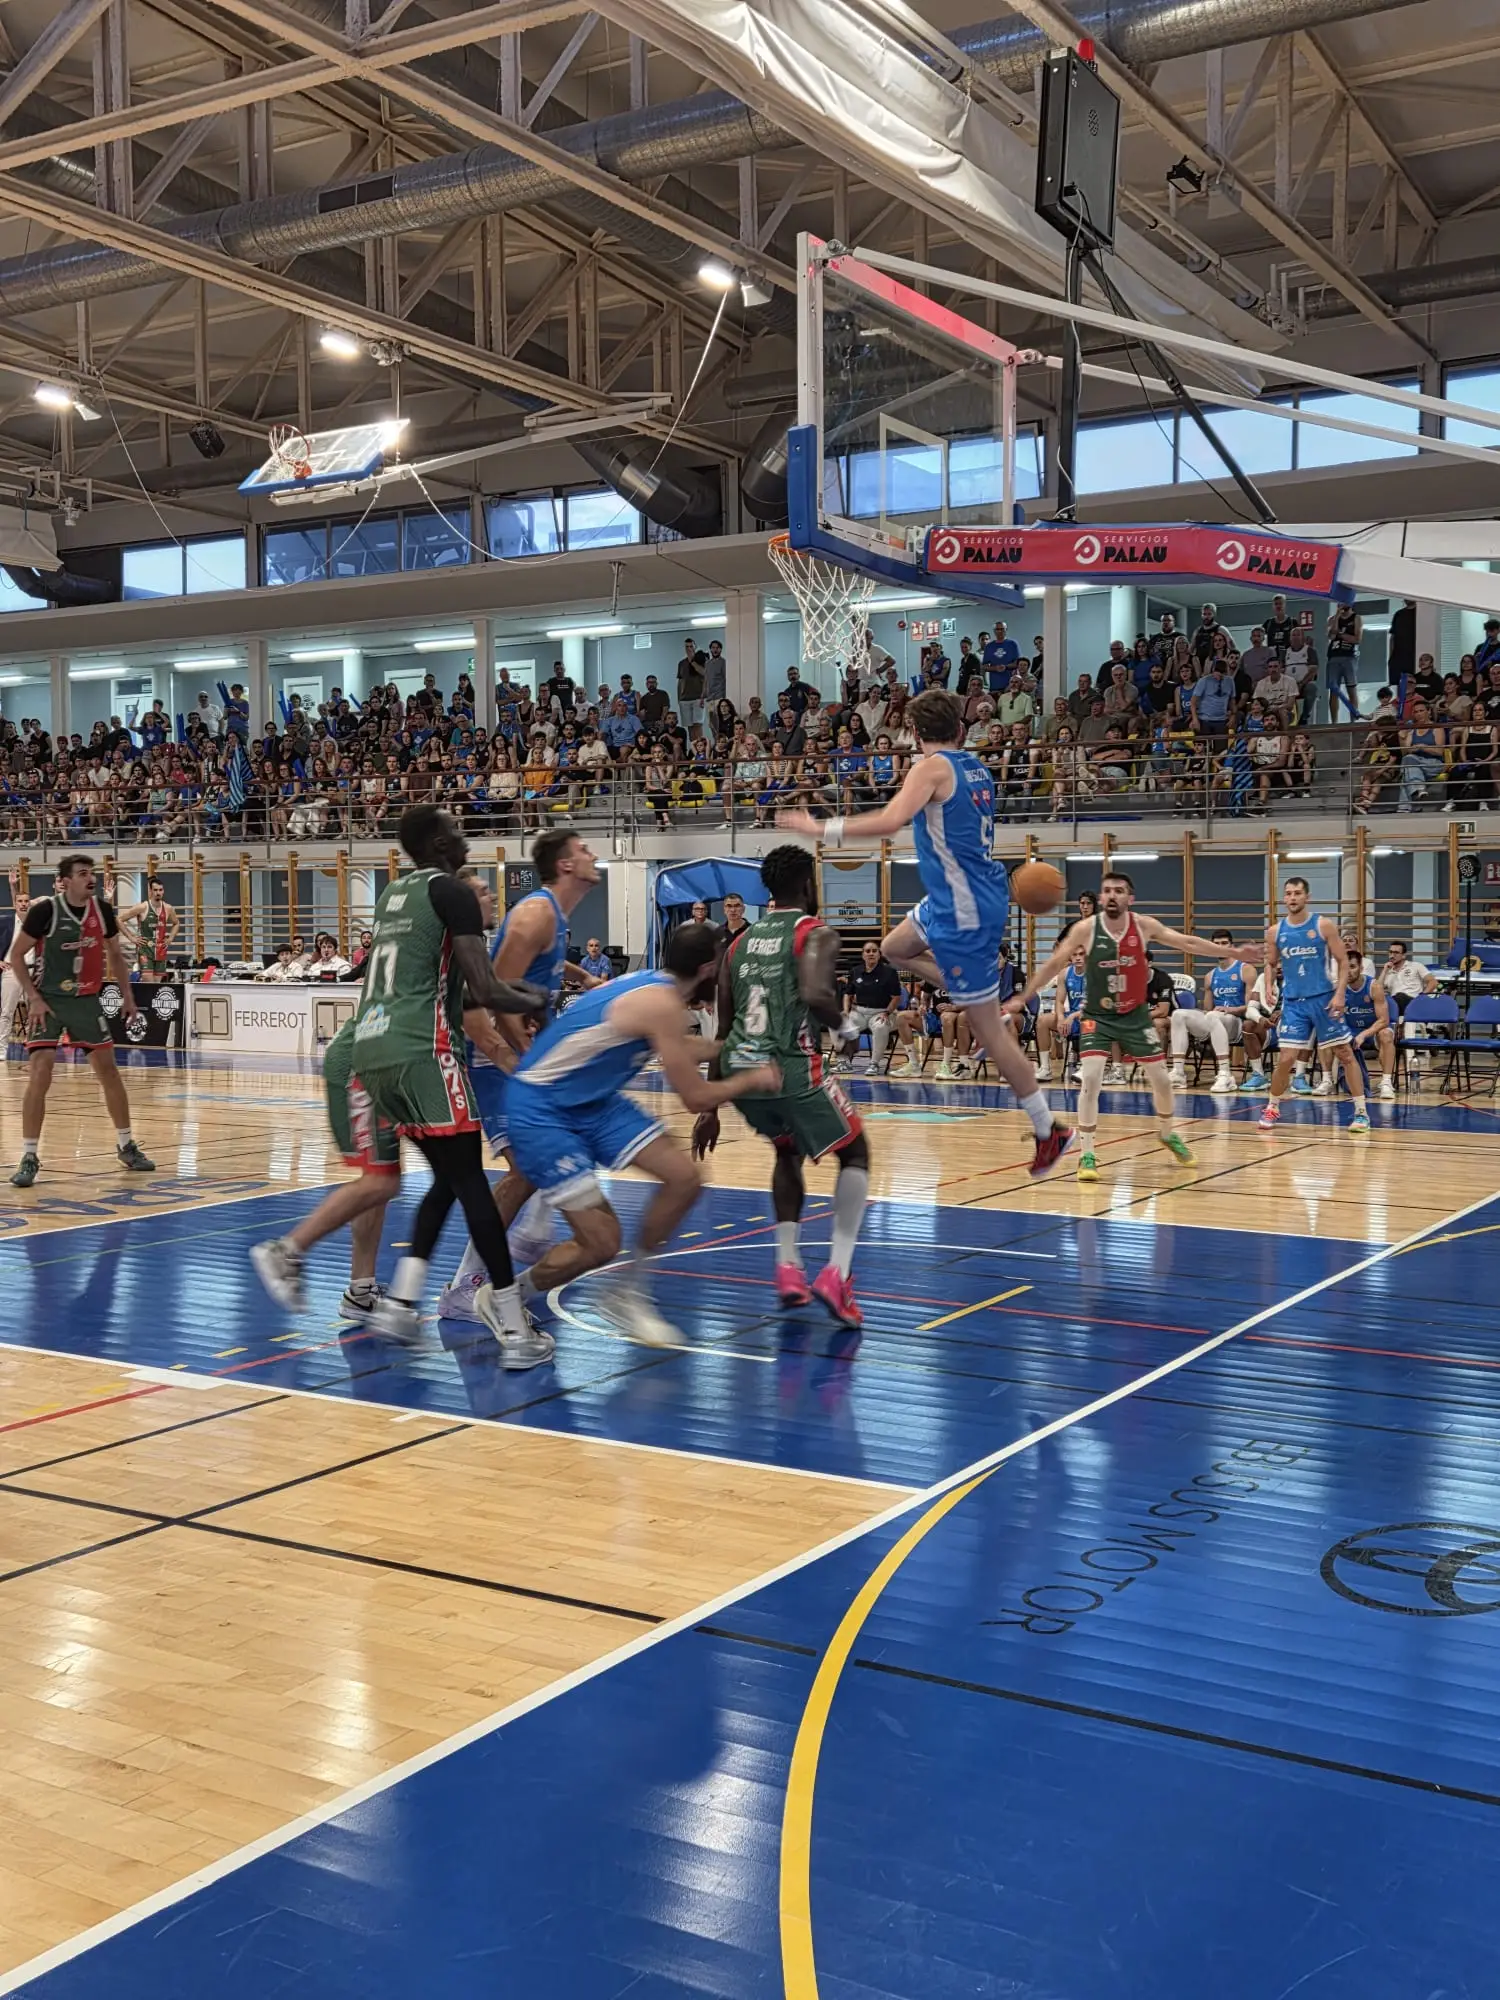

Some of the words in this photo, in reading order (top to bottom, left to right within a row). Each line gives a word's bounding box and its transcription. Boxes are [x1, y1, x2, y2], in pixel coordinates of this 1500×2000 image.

[962, 536, 1024, 545] SERVICIOS
[1103, 534, 1169, 544] SERVICIOS
[962, 546, 1024, 564] PALAU
[1103, 545, 1168, 564] PALAU
[1249, 543, 1319, 561] SERVICIOS
[1247, 559, 1317, 580] PALAU
[1297, 962, 1306, 977] 4
[234, 1010, 308, 1029] FERREROT
[1147, 1438, 1313, 1524] EBUSUS
[979, 1523, 1197, 1635] MOTOR
